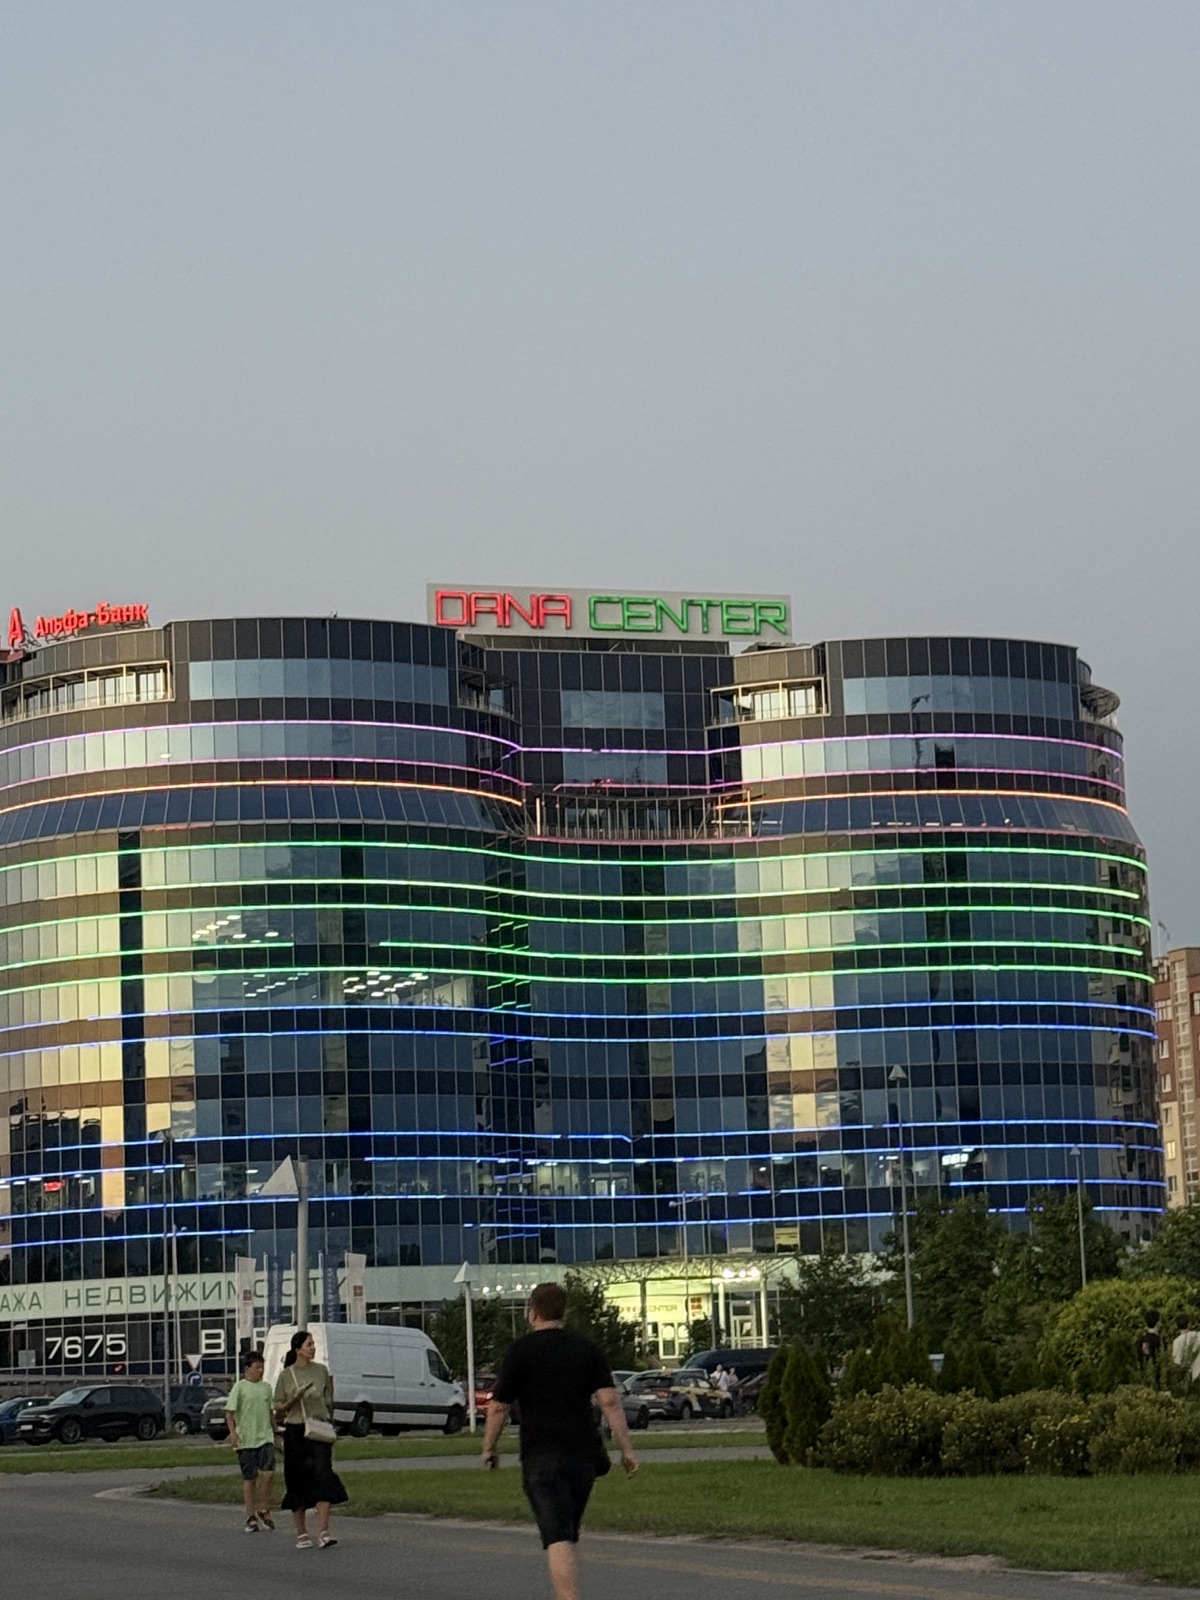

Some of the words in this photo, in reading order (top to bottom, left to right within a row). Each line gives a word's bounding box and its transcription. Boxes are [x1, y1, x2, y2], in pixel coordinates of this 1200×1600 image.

[435, 590, 572, 630] DANA
[588, 595, 788, 635] CENTER
[64, 1276, 346, 1308] НЕДВИЖИОСТ
[45, 1333, 127, 1360] 7675
